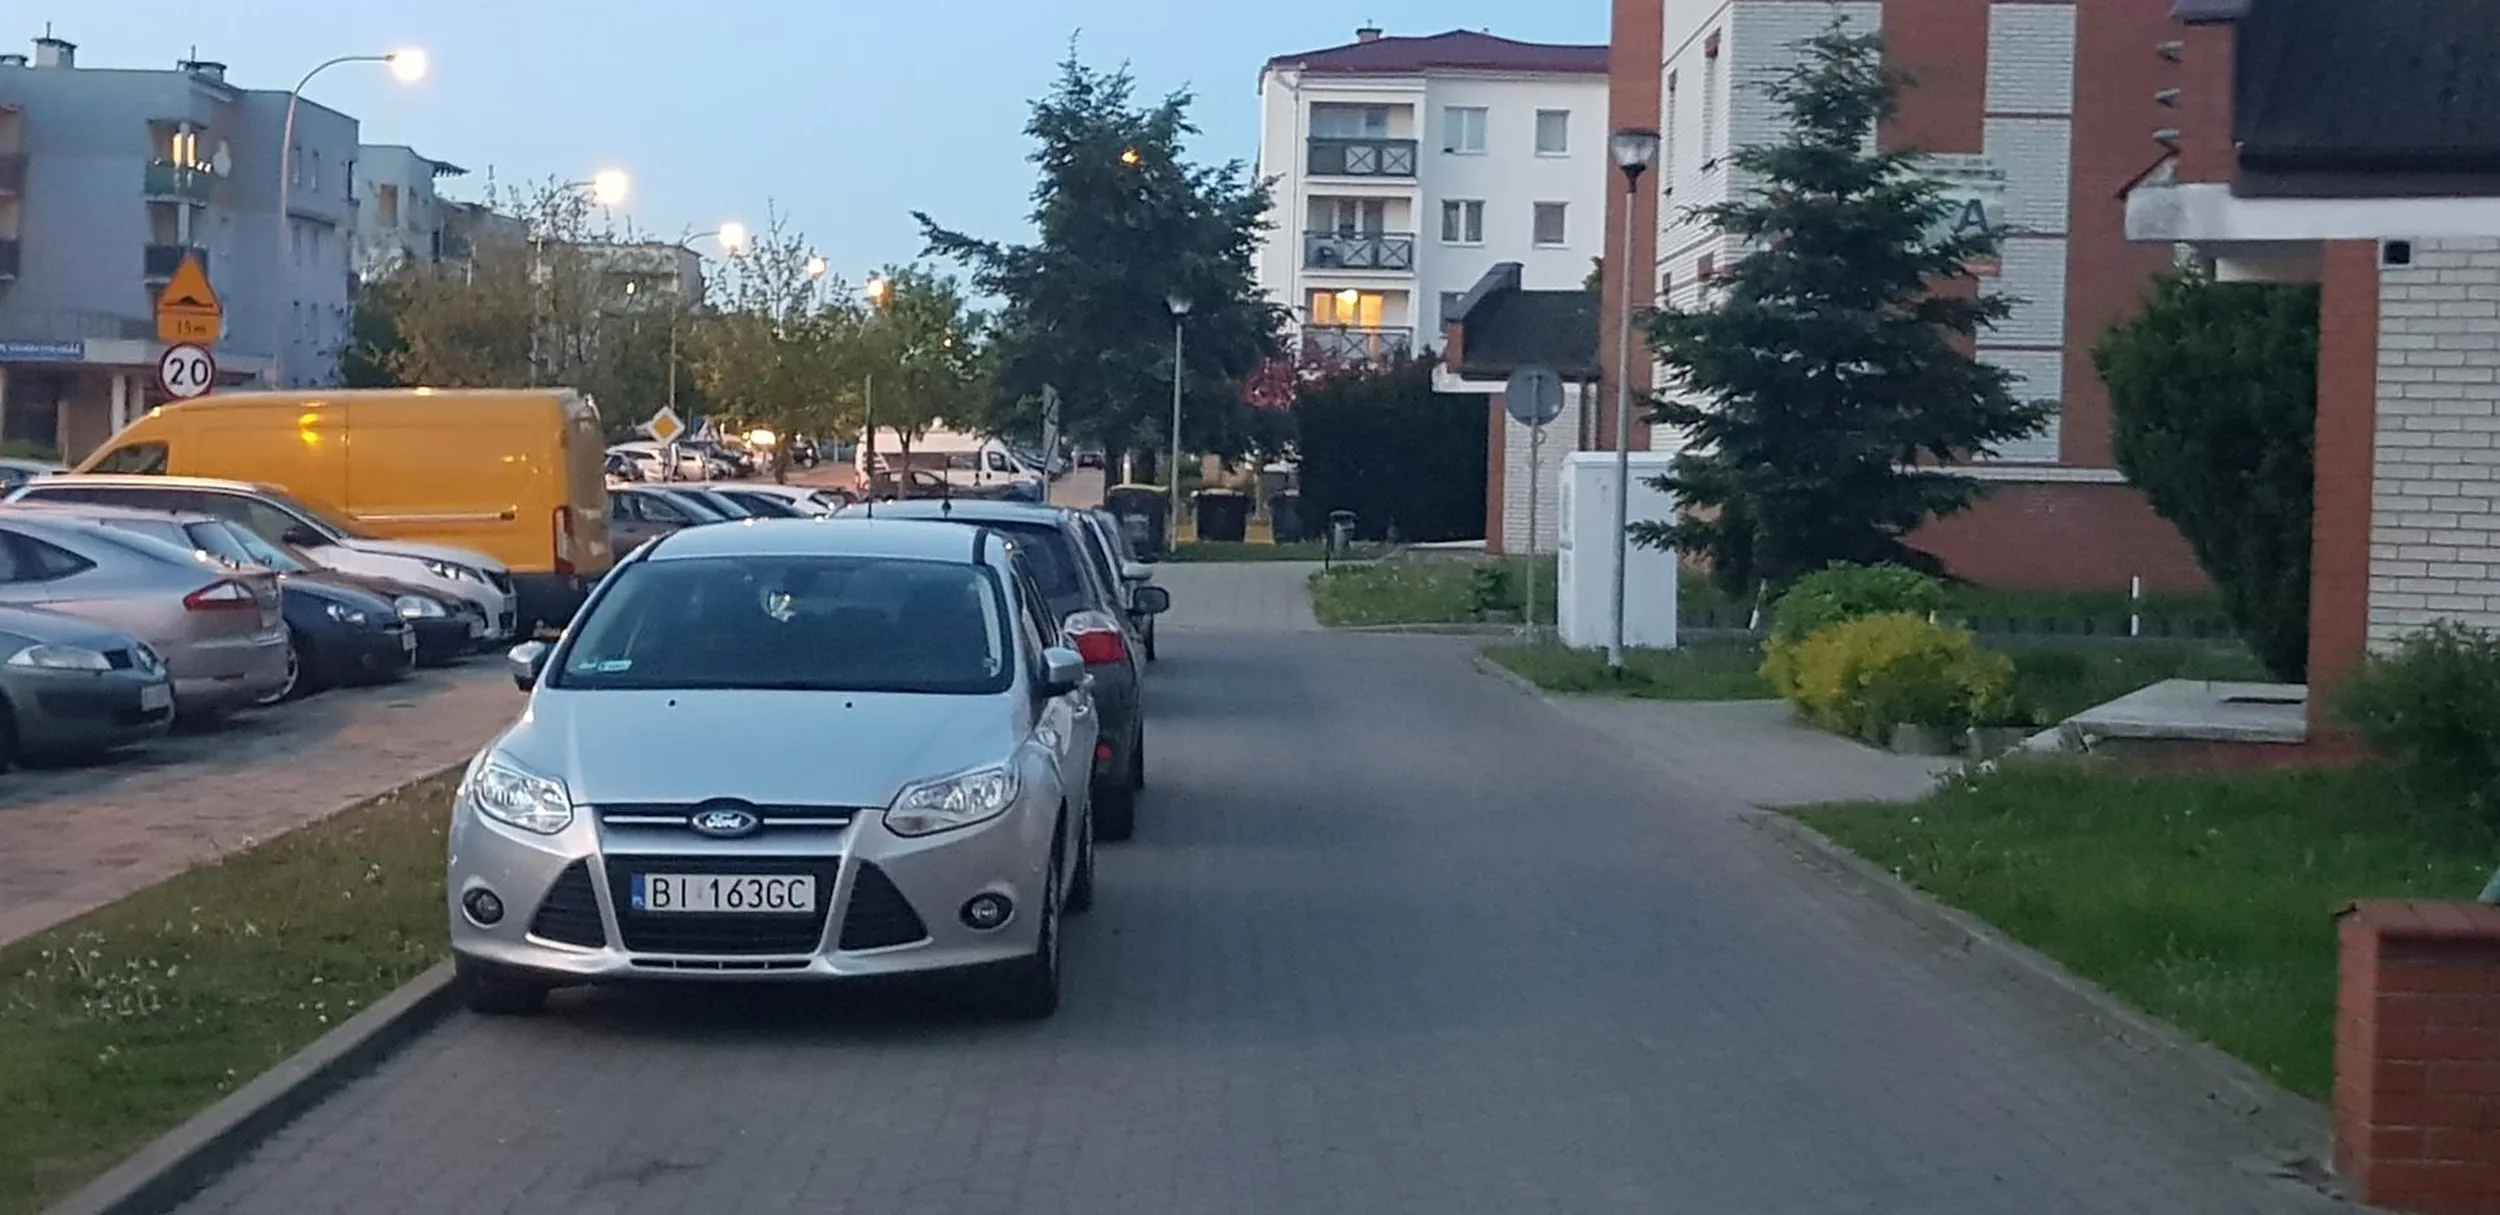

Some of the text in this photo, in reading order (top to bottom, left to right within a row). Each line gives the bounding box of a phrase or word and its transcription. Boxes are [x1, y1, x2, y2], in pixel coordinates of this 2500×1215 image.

[168, 357, 209, 387] 20
[705, 811, 743, 829] Ford
[652, 877, 687, 909] BI
[708, 878, 806, 910] 163GC
